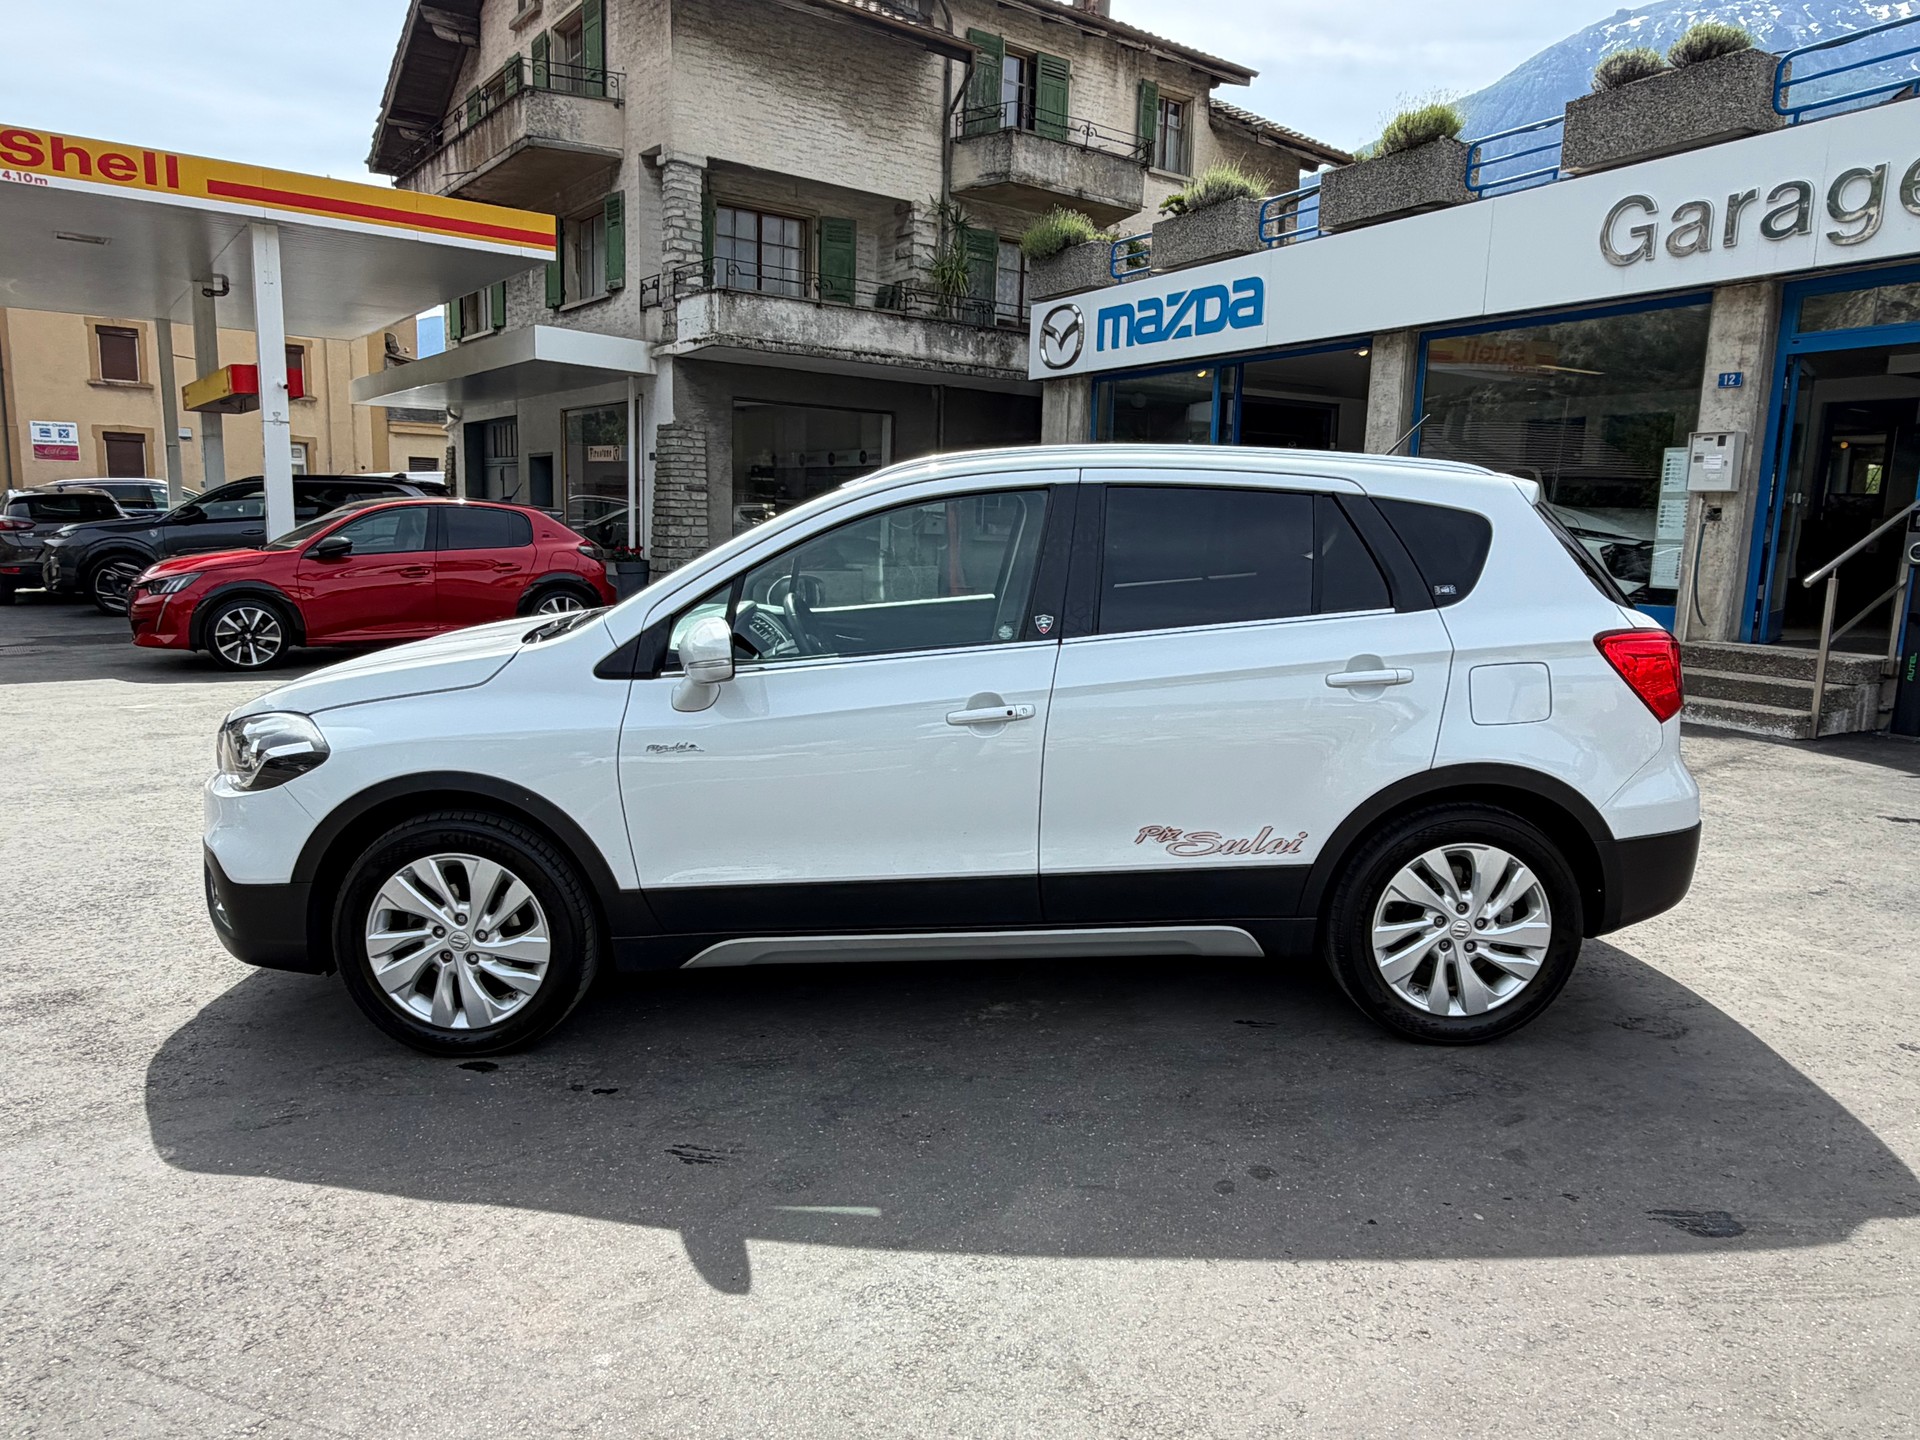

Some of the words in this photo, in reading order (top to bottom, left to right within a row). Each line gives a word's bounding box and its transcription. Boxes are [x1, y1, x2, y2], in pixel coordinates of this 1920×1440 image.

[0, 129, 179, 189] Shell
[2, 170, 48, 186] 4.10m
[1724, 374, 1736, 385] 12
[1906, 652, 1918, 682] AUTEL
[1134, 825, 1183, 845] Piz
[1165, 825, 1308, 857] Sulai
